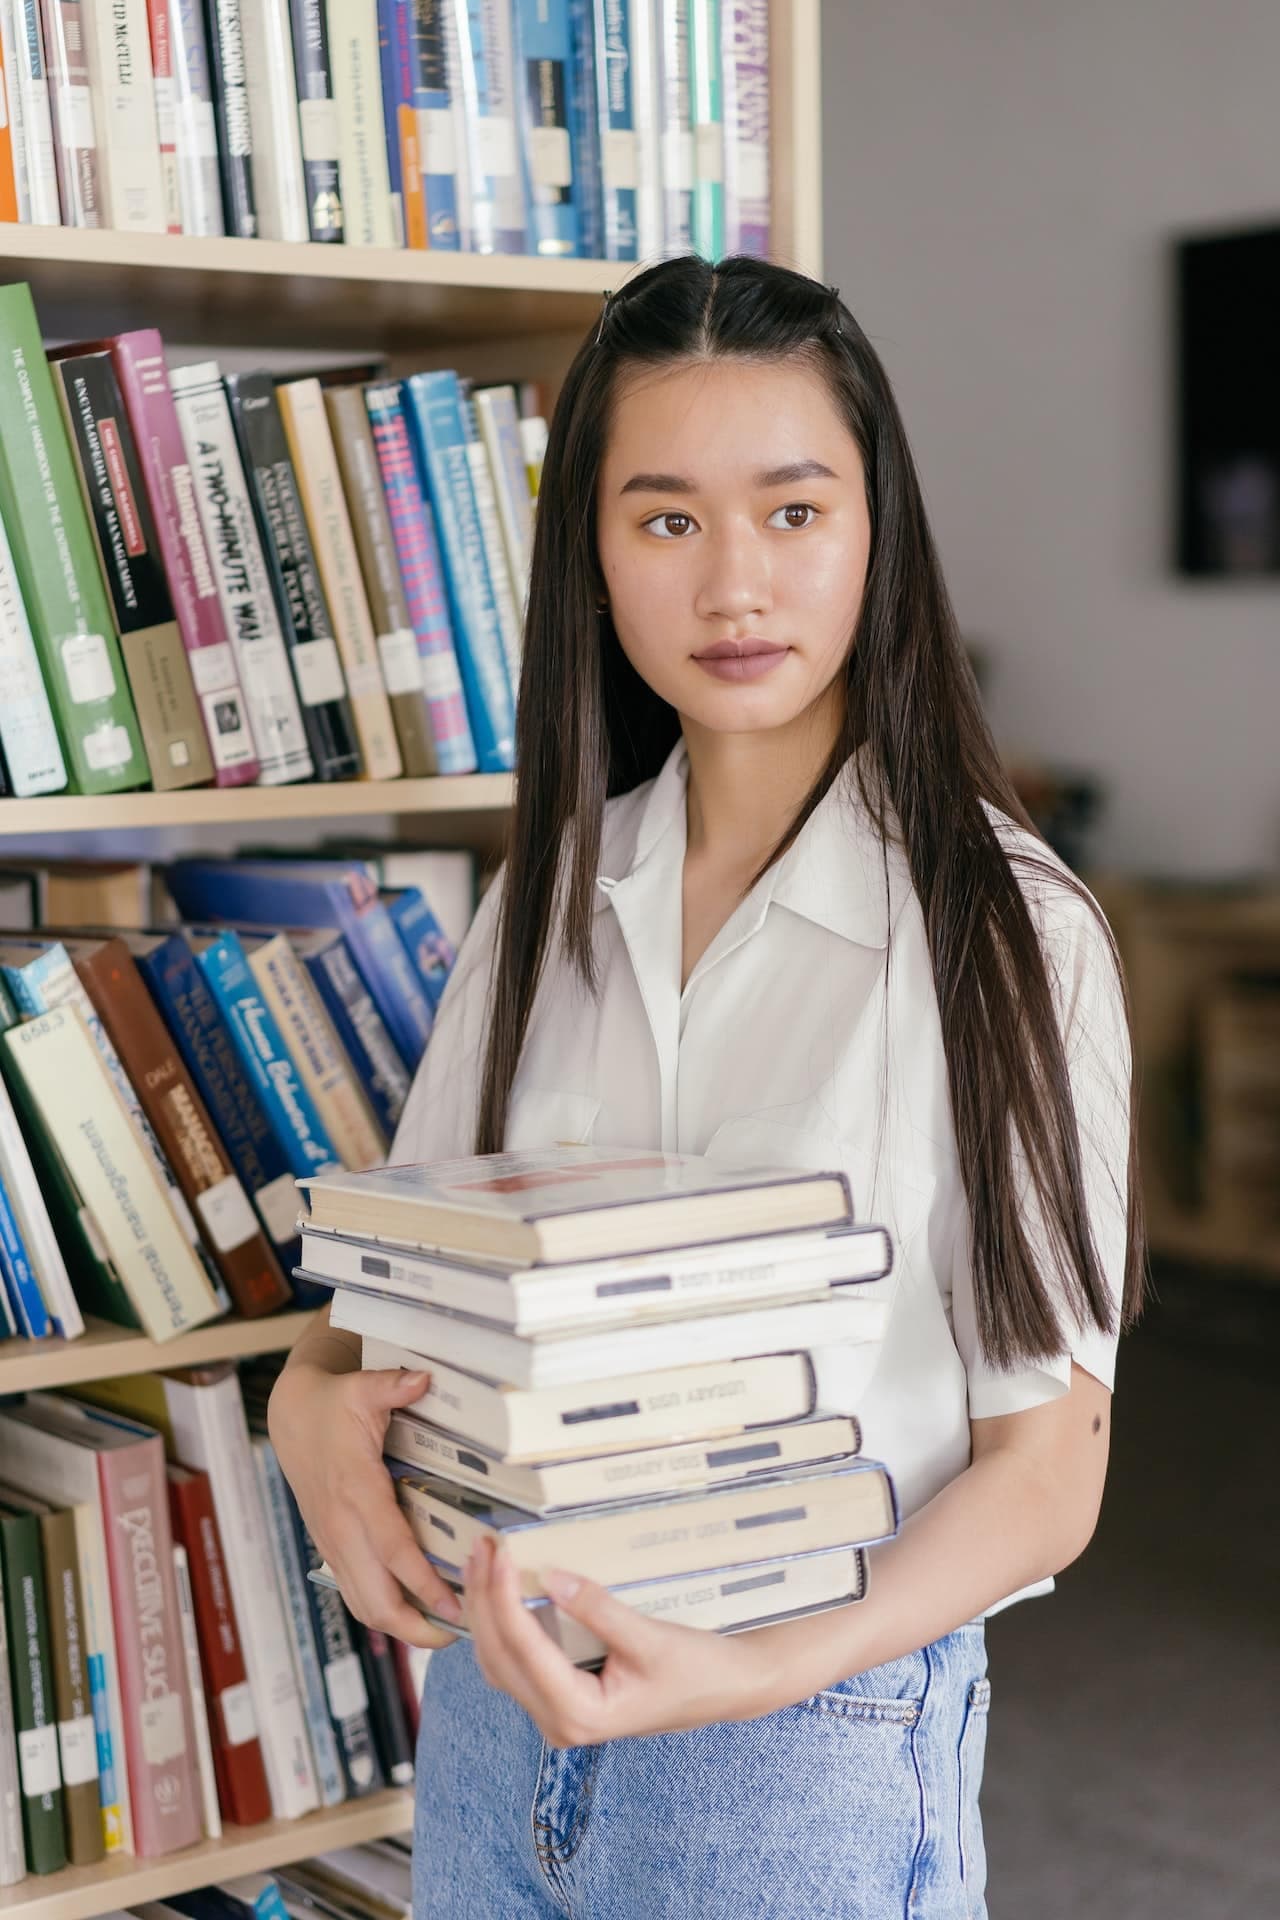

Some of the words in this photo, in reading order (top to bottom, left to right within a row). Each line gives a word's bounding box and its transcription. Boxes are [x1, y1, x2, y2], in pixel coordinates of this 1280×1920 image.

[70, 376, 107, 483] ENCYCLOPEDIA
[192, 441, 211, 457] A
[167, 463, 216, 599] Management
